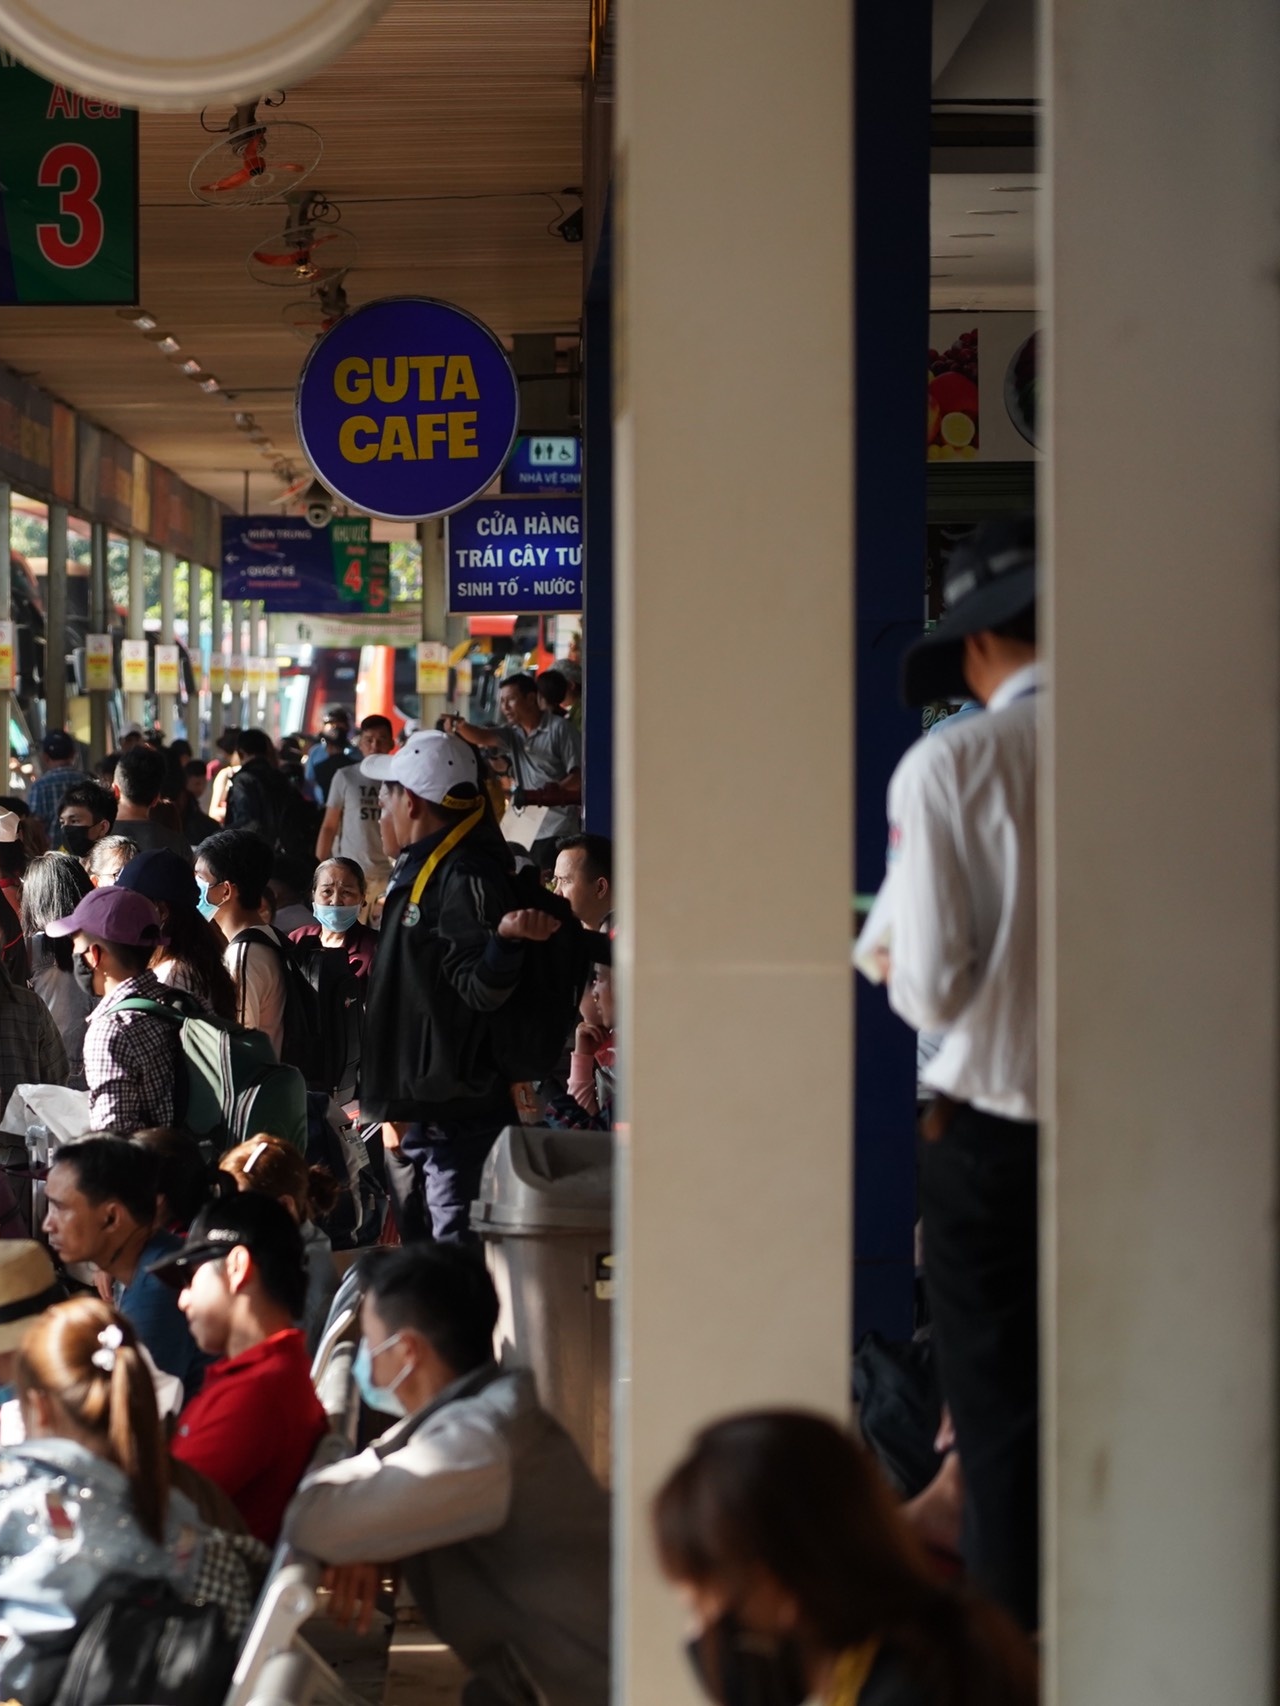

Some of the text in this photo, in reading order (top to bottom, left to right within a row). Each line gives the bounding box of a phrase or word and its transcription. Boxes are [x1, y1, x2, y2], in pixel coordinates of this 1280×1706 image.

[45, 83, 122, 120] Area
[36, 141, 105, 269] 3
[333, 354, 480, 406] GUTA
[337, 410, 480, 465] CAFE
[518, 471, 543, 483] NHÀ
[476, 510, 580, 536] CỬA HÀNG
[455, 543, 503, 568] TRÁI
[508, 543, 549, 568] CÂY
[343, 559, 364, 593] 4
[457, 582, 493, 597] SINH
[497, 576, 520, 596] TỐ
[533, 577, 576, 595] NƯỚC
[368, 578, 387, 608] 5
